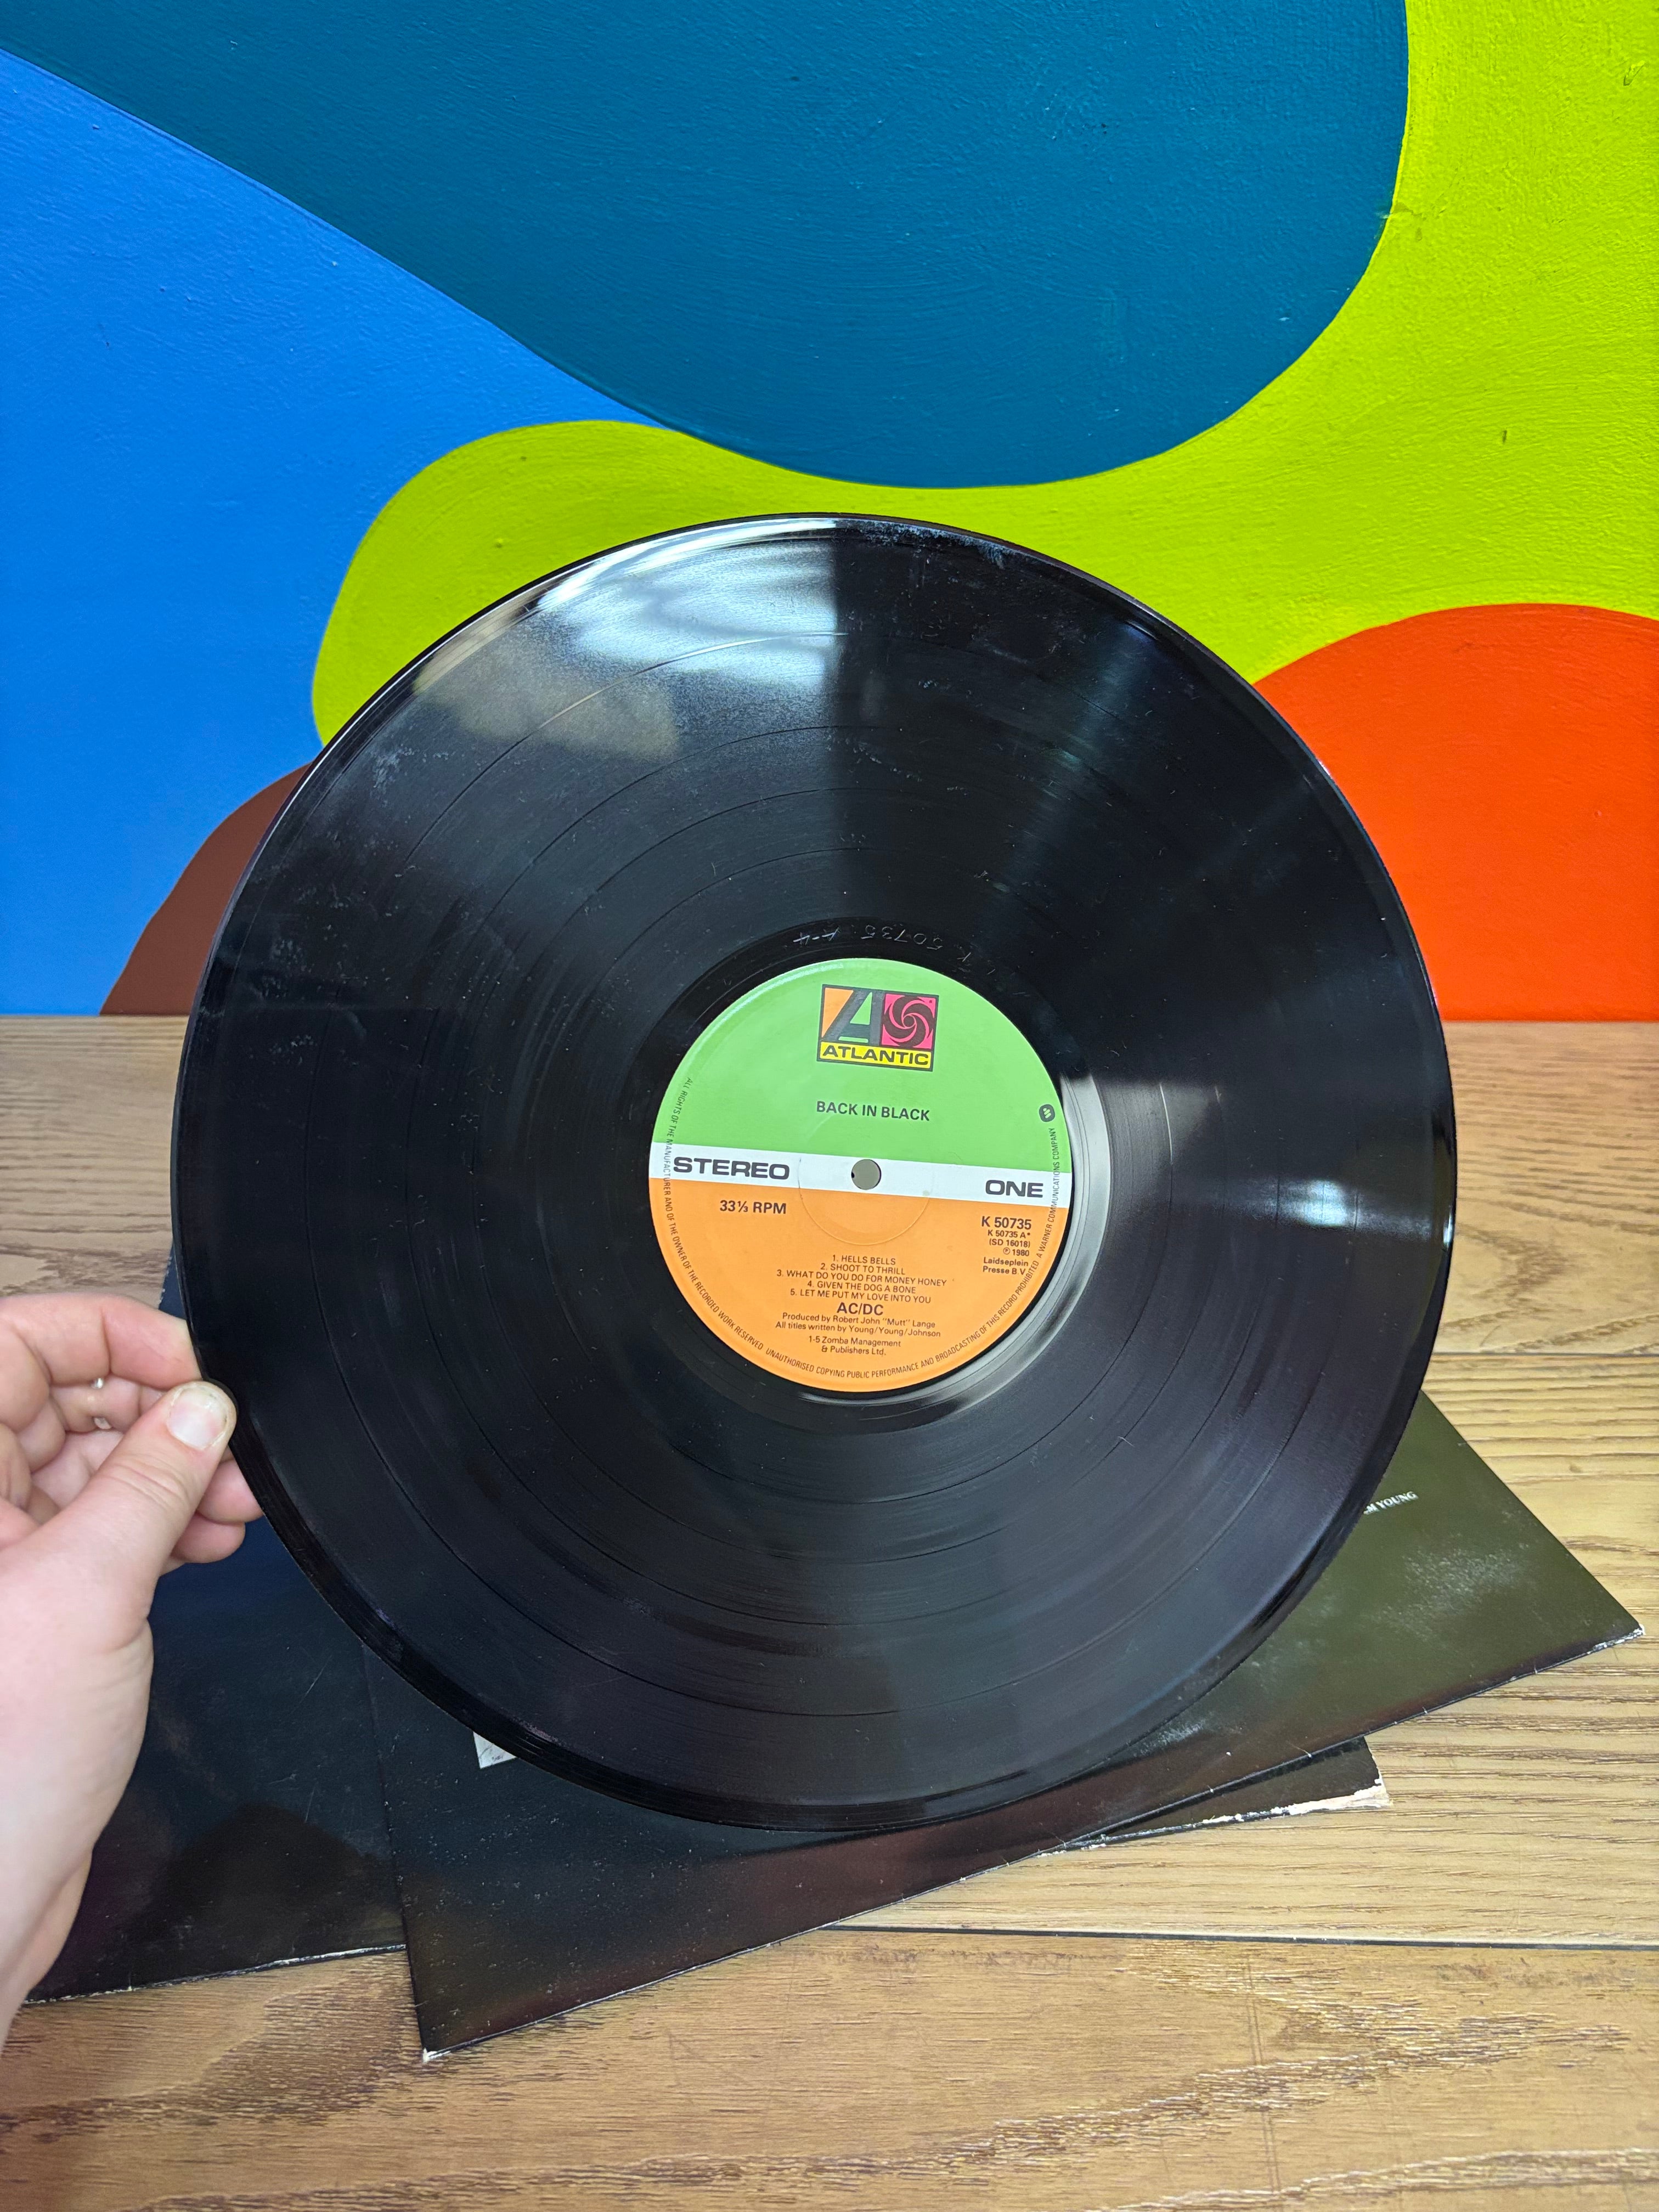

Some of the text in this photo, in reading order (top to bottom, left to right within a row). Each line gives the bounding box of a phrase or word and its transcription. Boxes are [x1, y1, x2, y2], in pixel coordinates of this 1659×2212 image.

[823, 1045, 929, 1065] ATLANTIC
[683, 1077, 693, 1089] ALL
[673, 1091, 688, 1114] RIGHTS
[817, 1101, 930, 1121] BACK IN BLACK
[671, 1114, 679, 1124] OF
[667, 1125, 676, 1137] THE
[1049, 1128, 1059, 1160] COMPANY
[663, 1139, 673, 1196] MANUFACTURER
[674, 1156, 1043, 1198] STEREO ONE
[1047, 1161, 1060, 1223] COMMUNICATIONS
[664, 1197, 673, 1212] AND
[753, 1201, 787, 1214] RPM
[667, 1213, 674, 1221] OF
[981, 1216, 1031, 1230] K 50735
[669, 1222, 678, 1235] THE
[1006, 1240, 1030, 1248] 16018)
[1038, 1223, 1052, 1252] WARNER
[672, 1236, 687, 1261] OWNER
[682, 1261, 691, 1269] OF
[842, 1255, 868, 1263] HELLS
[870, 1257, 896, 1265] BELLS
[688, 1269, 698, 1283] THE
[831, 1263, 861, 1272] SHOOT
[877, 1266, 905, 1275] THRILL
[983, 1266, 1009, 1274] Presse
[786, 1270, 814, 1278] WHAT
[885, 1276, 916, 1284] MONEY
[1015, 1260, 1039, 1296] PROHIBITED
[817, 1281, 843, 1289] GIVEN
[893, 1285, 916, 1294] BONE
[695, 1282, 719, 1313] RECORDED
[837, 1302, 884, 1316] AC/DC
[997, 1294, 1018, 1316] RECORD
[718, 1310, 736, 1329] WORK
[783, 1312, 820, 1322] Produced
[822, 1314, 831, 1323] by
[912, 1320, 935, 1329] Lange
[986, 1314, 1000, 1328] THIS
[788, 1322, 806, 1330] titles
[808, 1323, 835, 1331] written
[837, 1325, 847, 1333] by
[849, 1325, 941, 1337] Young/Young/Johnson
[979, 1325, 988, 1334] OF
[734, 1325, 764, 1350] RESERVED
[851, 1338, 901, 1348] Management
[831, 1346, 870, 1355] Publishers
[872, 1348, 887, 1356] Ltd.
[935, 1331, 981, 1362] BROADCASTING
[766, 1348, 814, 1372] UNAUTHORISED
[921, 1357, 934, 1368] AND
[816, 1366, 845, 1378] COPYING
[872, 1363, 918, 1378] PERFORMANCE
[1375, 1491, 1419, 1509] YOUNG
